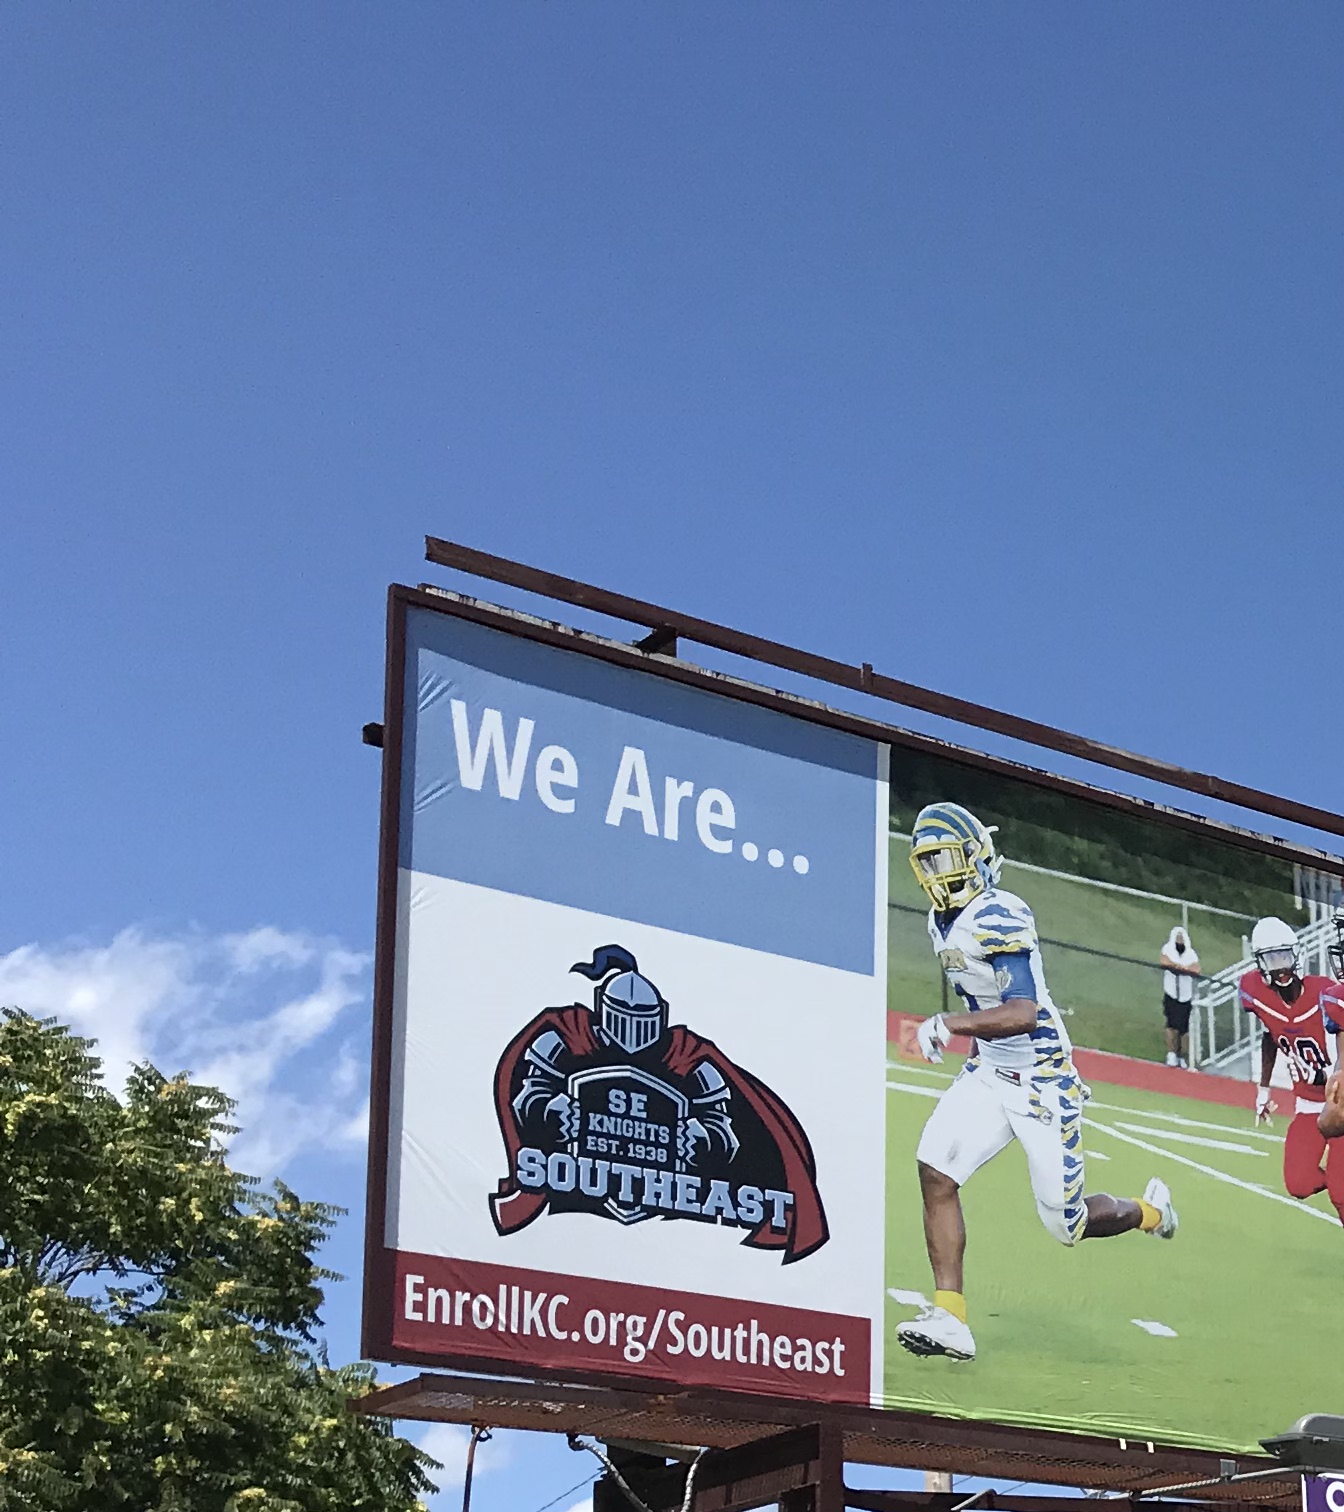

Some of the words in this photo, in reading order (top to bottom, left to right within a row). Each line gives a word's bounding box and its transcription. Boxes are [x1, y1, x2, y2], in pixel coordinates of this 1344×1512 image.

[451, 699, 578, 813] We
[605, 746, 809, 875] Are...
[588, 1112, 670, 1143] KNIGHTS
[608, 1088, 648, 1118] SE
[586, 1136, 623, 1156] EST.
[627, 1142, 668, 1163] 1938
[516, 1147, 794, 1228] SOUTHEAST
[404, 1273, 845, 1376] EnrollKC.org/Southeast
